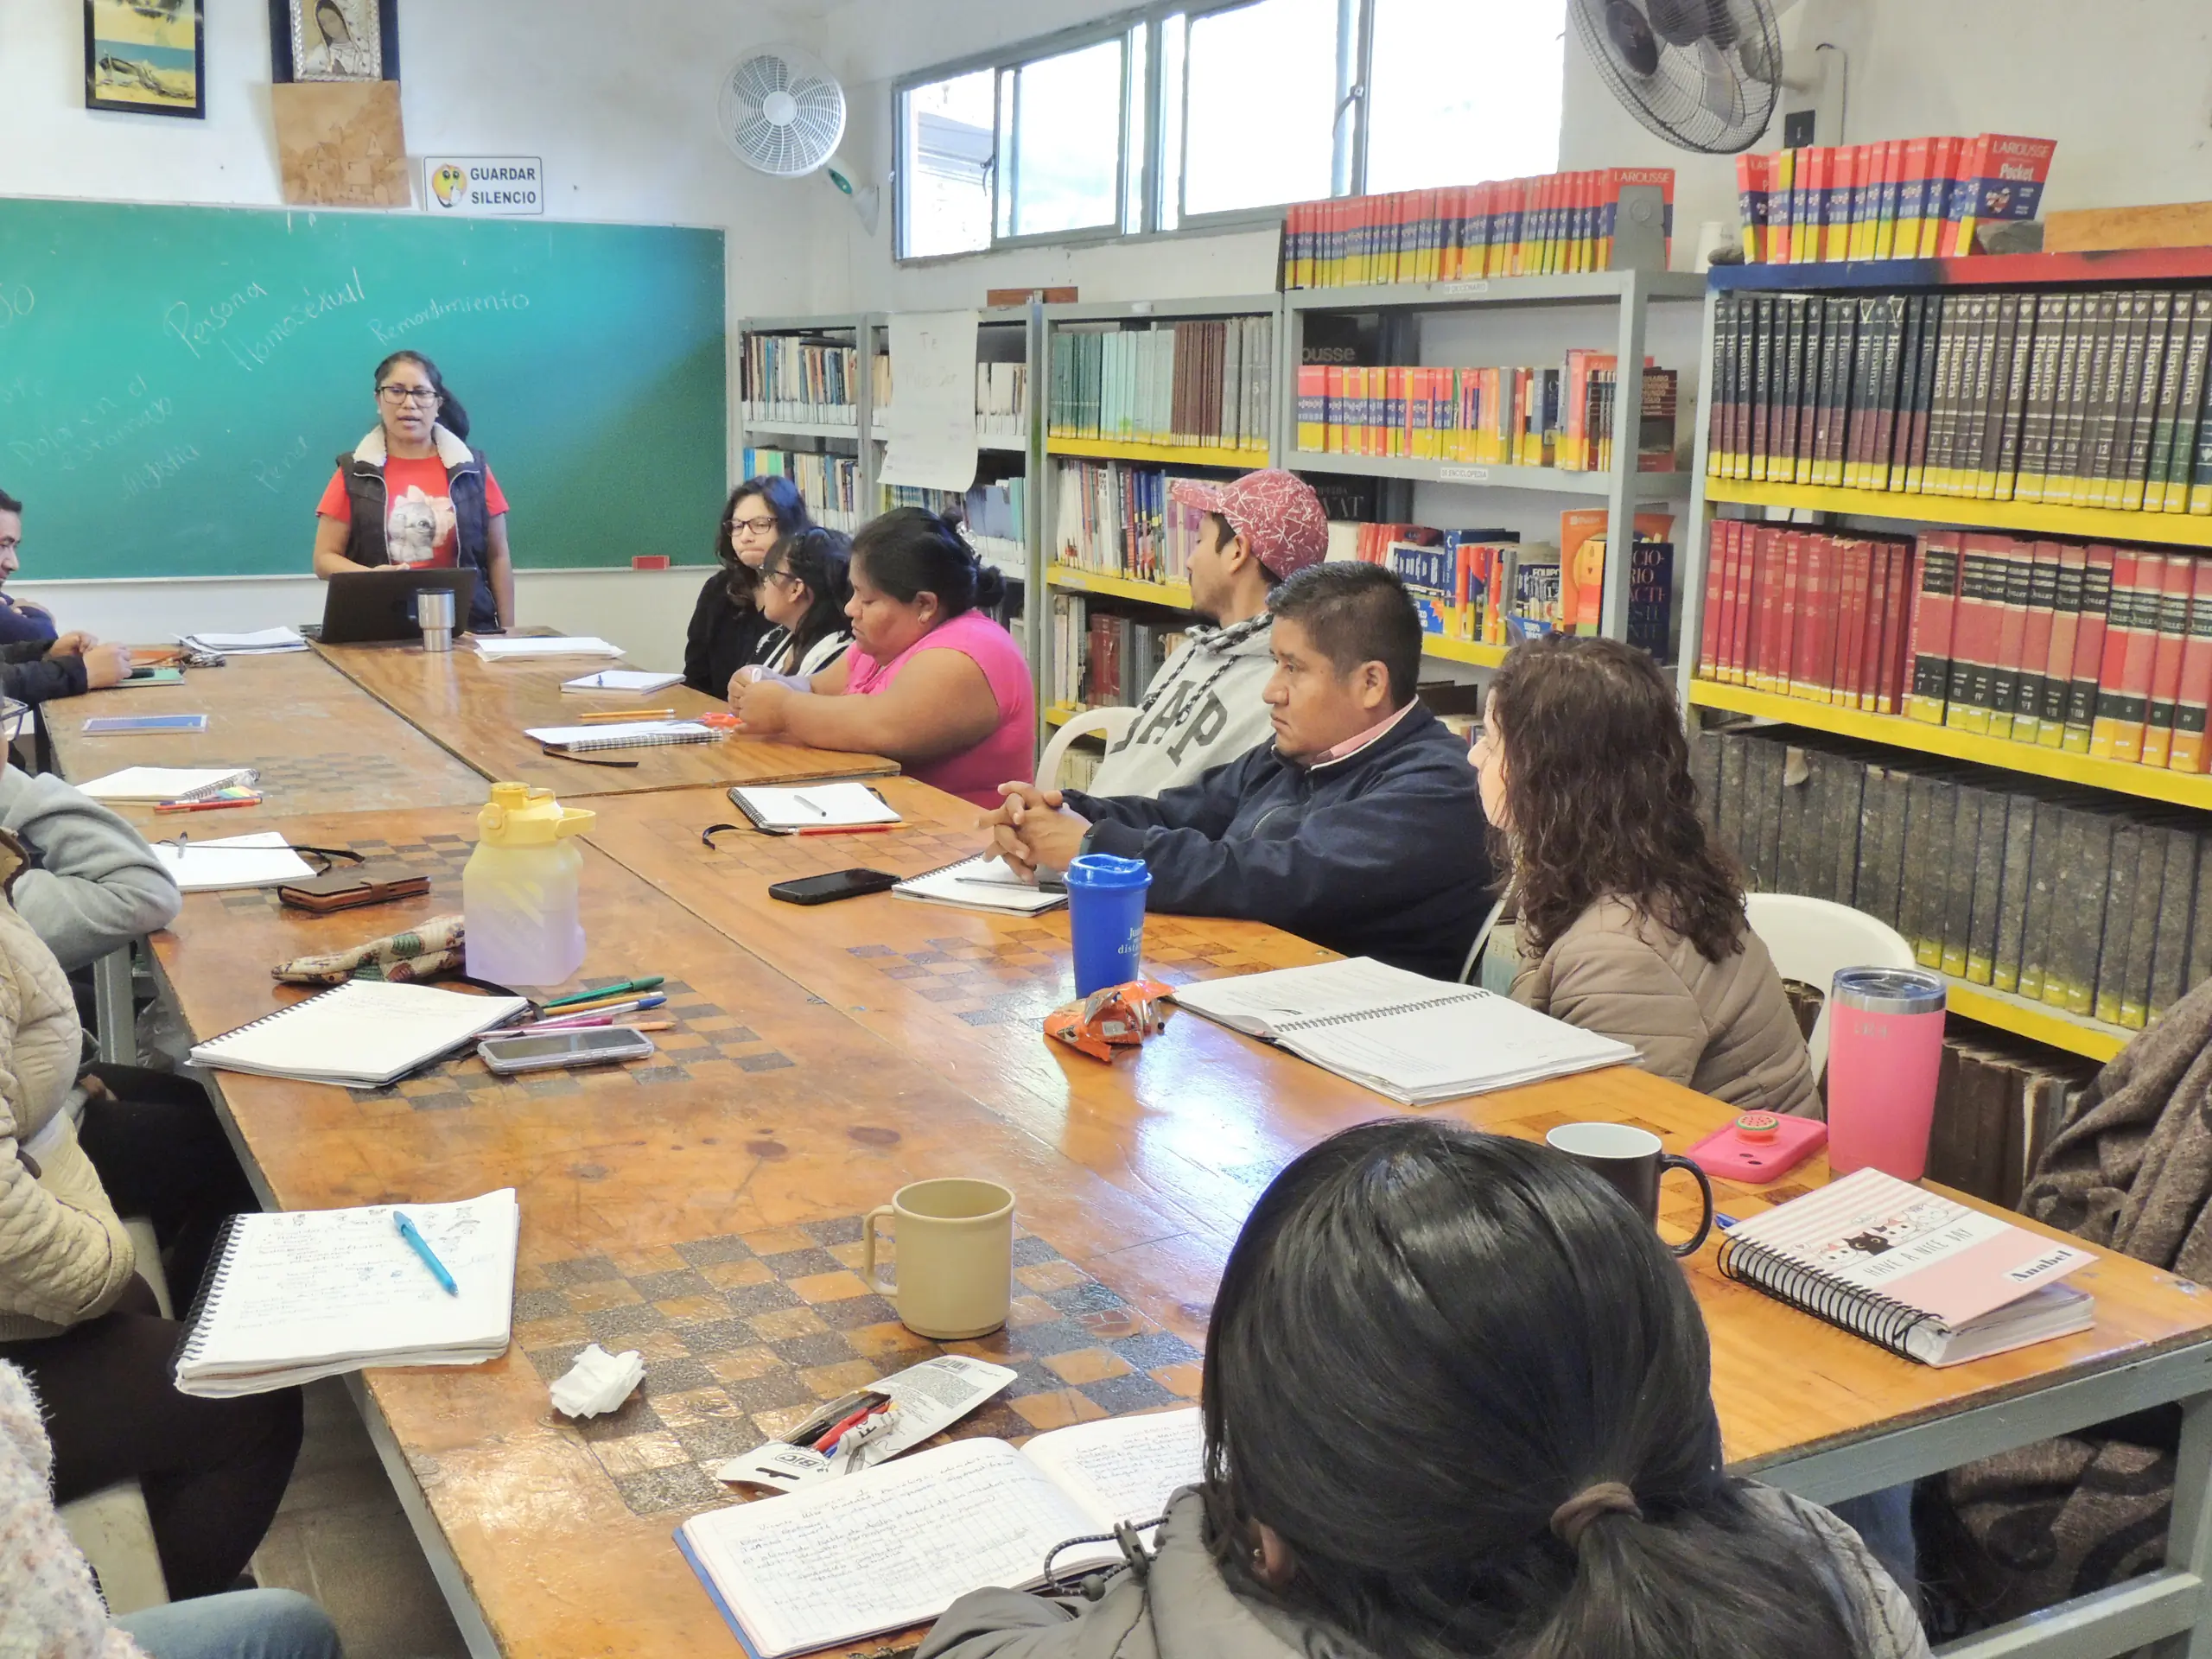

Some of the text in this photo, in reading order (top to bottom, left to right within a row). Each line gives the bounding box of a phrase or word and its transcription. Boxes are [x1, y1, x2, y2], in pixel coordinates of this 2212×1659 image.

[1993, 140, 2050, 157] LAROUSSE
[469, 167, 537, 181] GUARDAR
[1613, 170, 1670, 183] LAROUSSE
[1999, 163, 2034, 181] Pocket
[471, 190, 537, 205] SILENCIO
[163, 279, 269, 360] Persona
[365, 289, 531, 346] Remordimiento
[1302, 346, 1356, 362] ousse
[1863, 1228, 1974, 1277] HAVE A NICE DAY
[2011, 1249, 2074, 1283] Anabel
[777, 1454, 820, 1468] BIC
